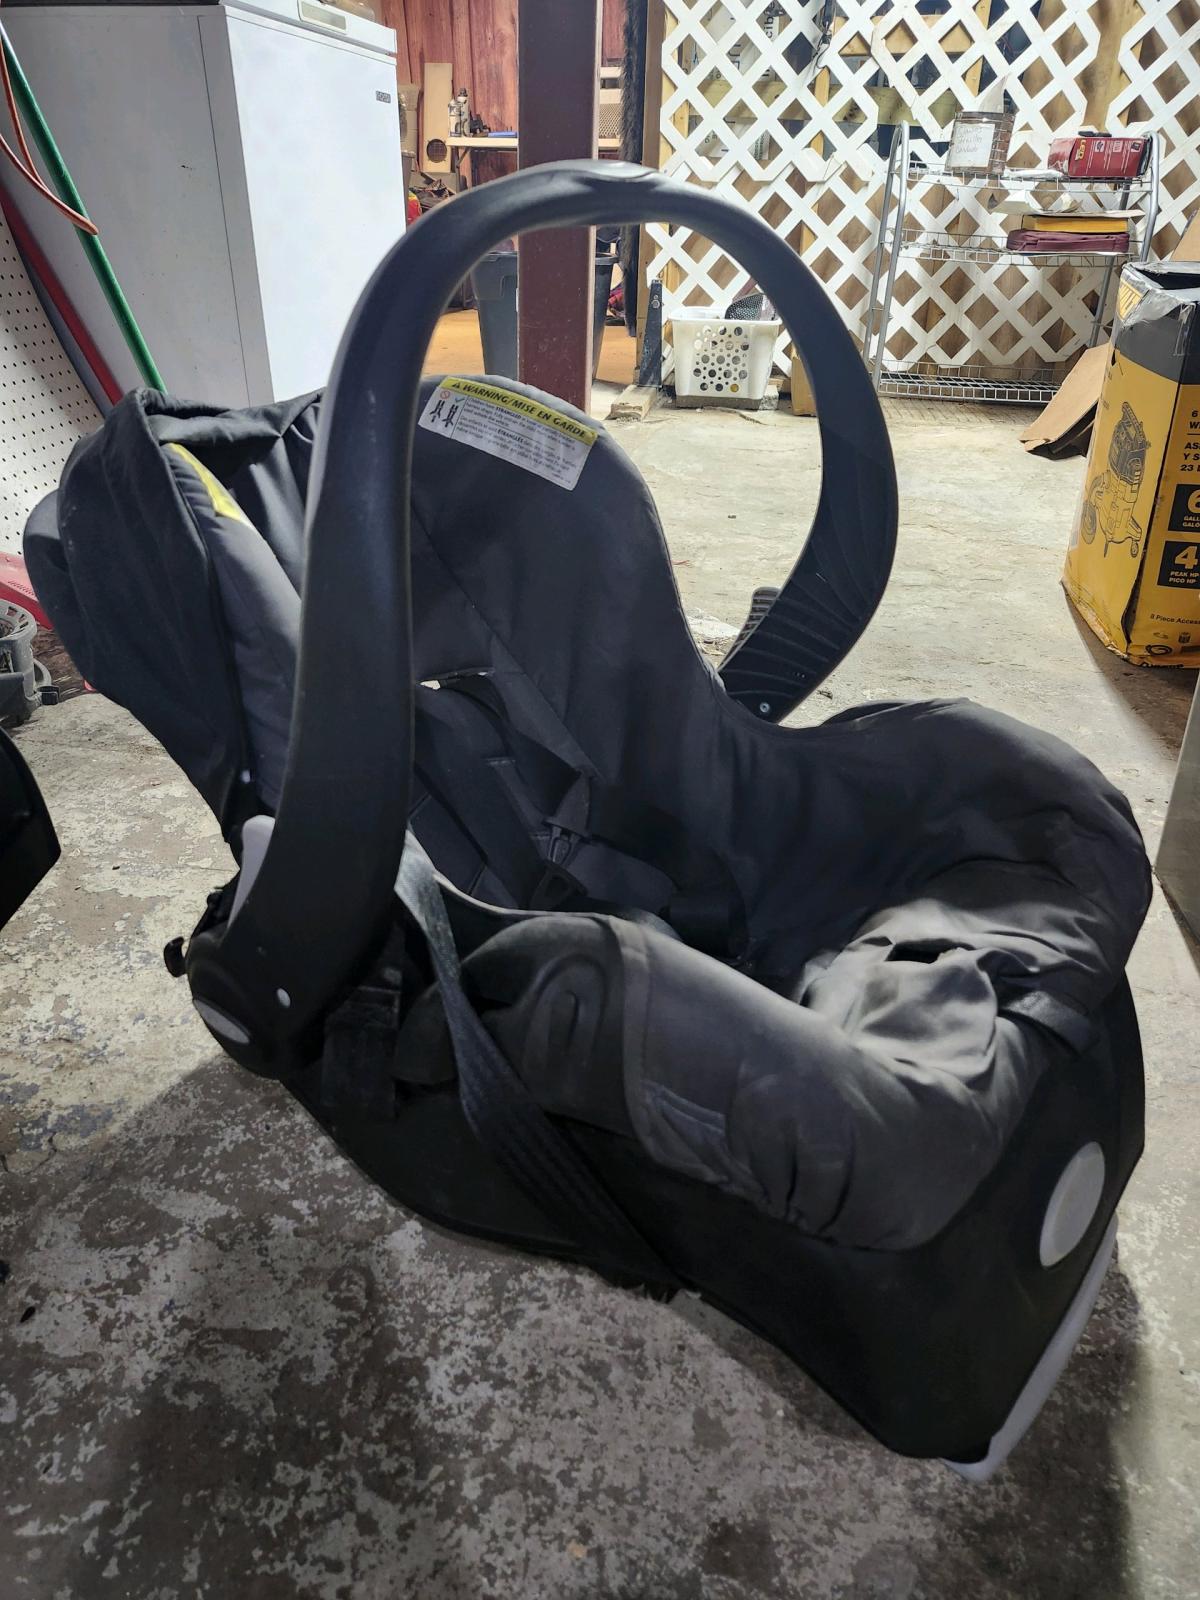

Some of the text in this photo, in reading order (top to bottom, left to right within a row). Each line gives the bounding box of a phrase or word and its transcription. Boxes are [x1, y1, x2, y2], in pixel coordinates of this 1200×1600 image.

[463, 384, 537, 414] WARNING/MISE
[537, 409, 552, 421] EN
[553, 417, 586, 439] GARDE
[1191, 410, 1198, 418] 6
[1180, 464, 1194, 472] 23
[1174, 545, 1199, 570] 4
[1156, 614, 1175, 623] Piece
